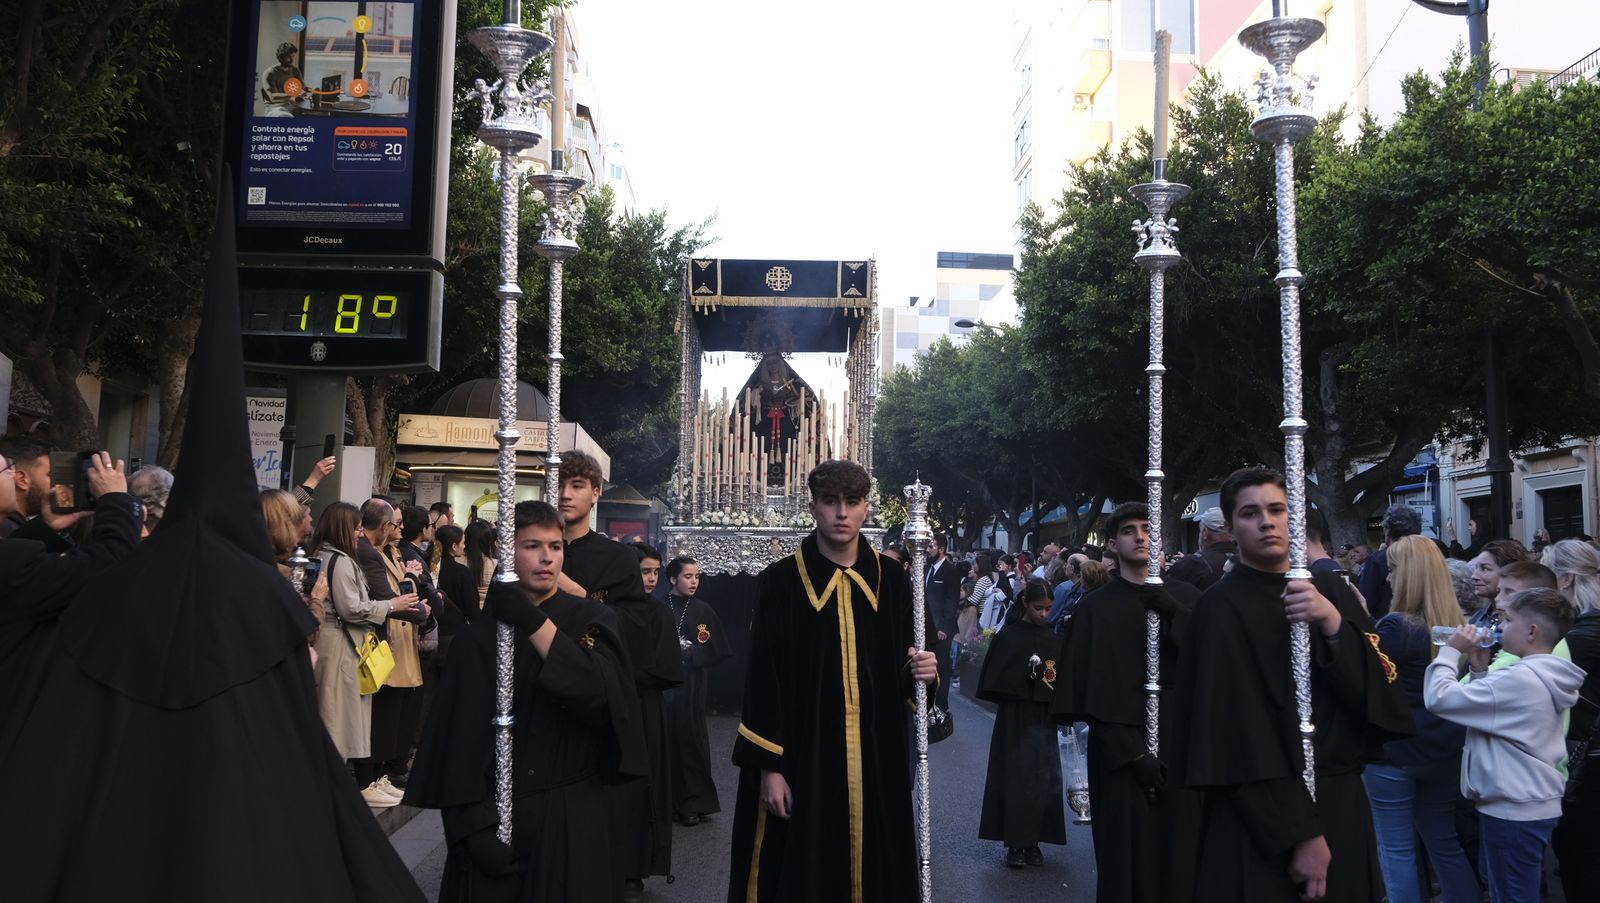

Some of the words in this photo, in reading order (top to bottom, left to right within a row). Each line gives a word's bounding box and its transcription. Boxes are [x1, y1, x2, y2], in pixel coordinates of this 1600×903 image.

[286, 126, 315, 135] energía
[385, 143, 402, 155] 20
[250, 153, 291, 161] repostajes
[304, 236, 343, 244] JCDecaux
[250, 399, 285, 408] Navidad
[255, 438, 278, 447] Enero
